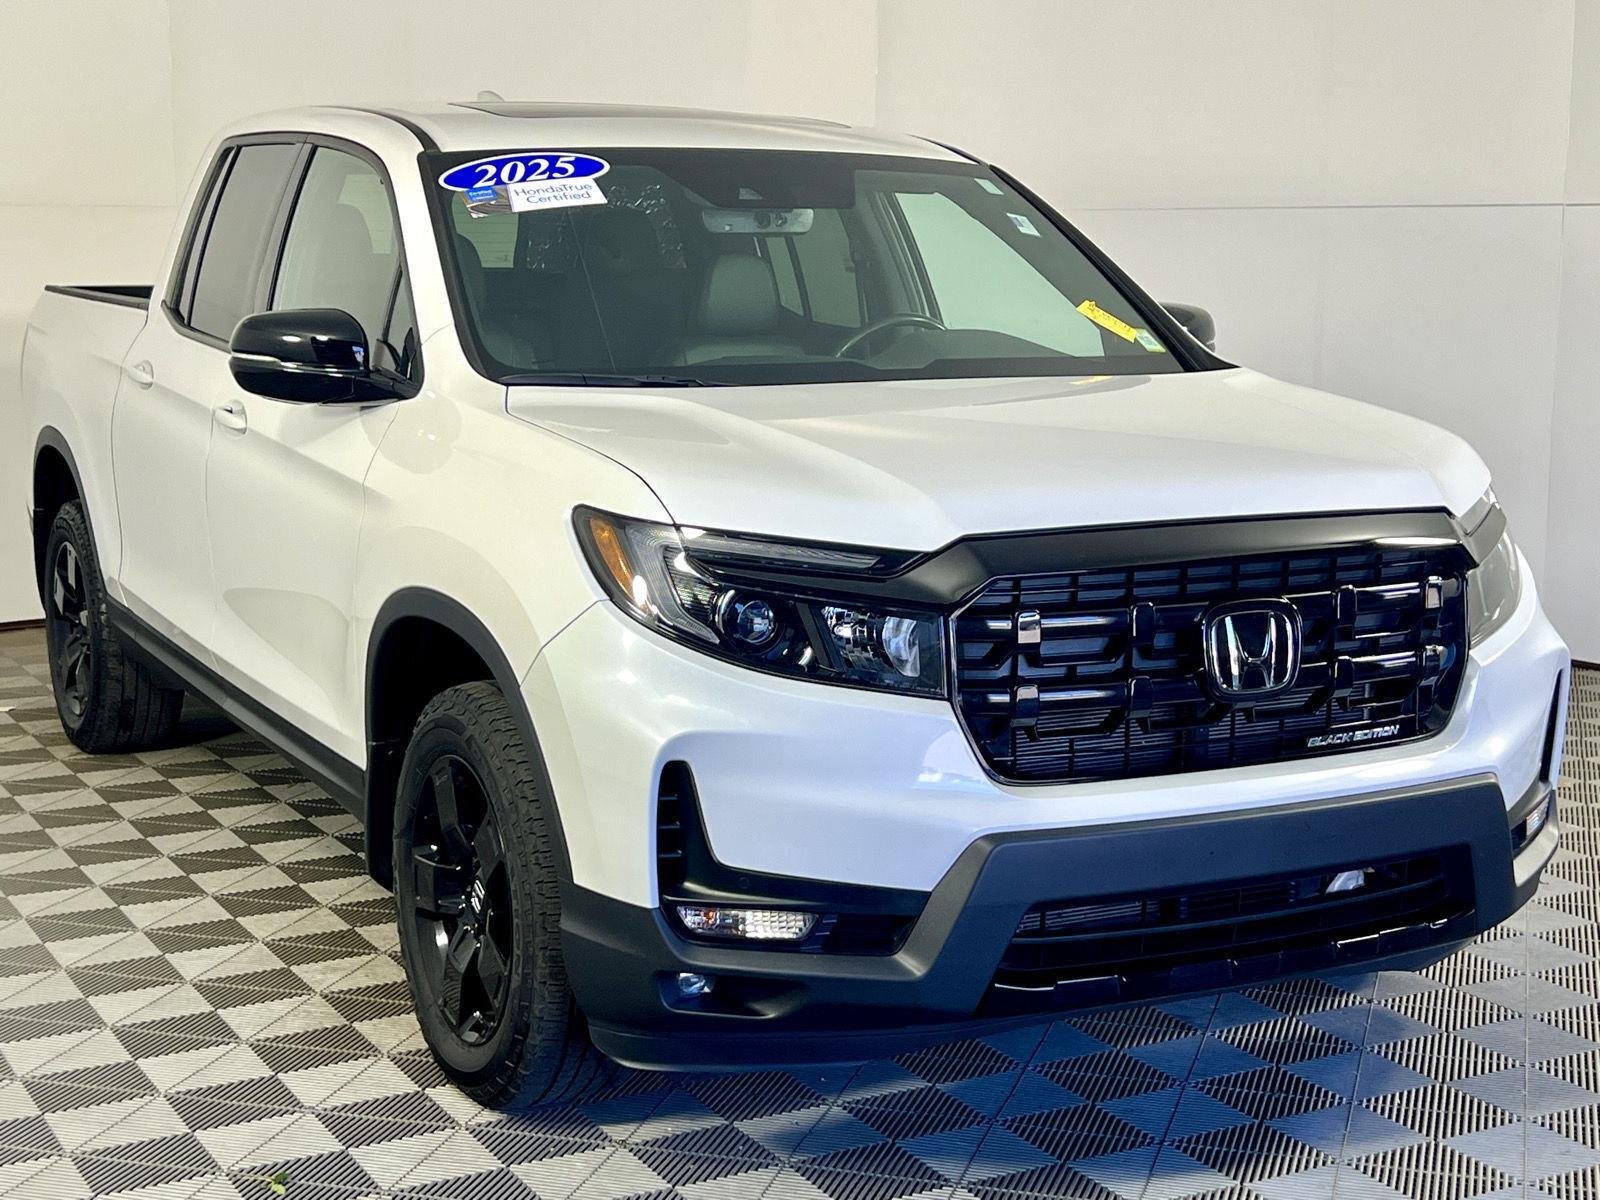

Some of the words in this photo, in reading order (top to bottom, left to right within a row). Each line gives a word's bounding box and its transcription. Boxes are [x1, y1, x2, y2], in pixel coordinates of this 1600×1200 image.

[472, 156, 576, 188] 2025
[526, 191, 592, 204] Certified
[1307, 732, 1353, 747] BLACK
[1353, 725, 1400, 741] EDITION
